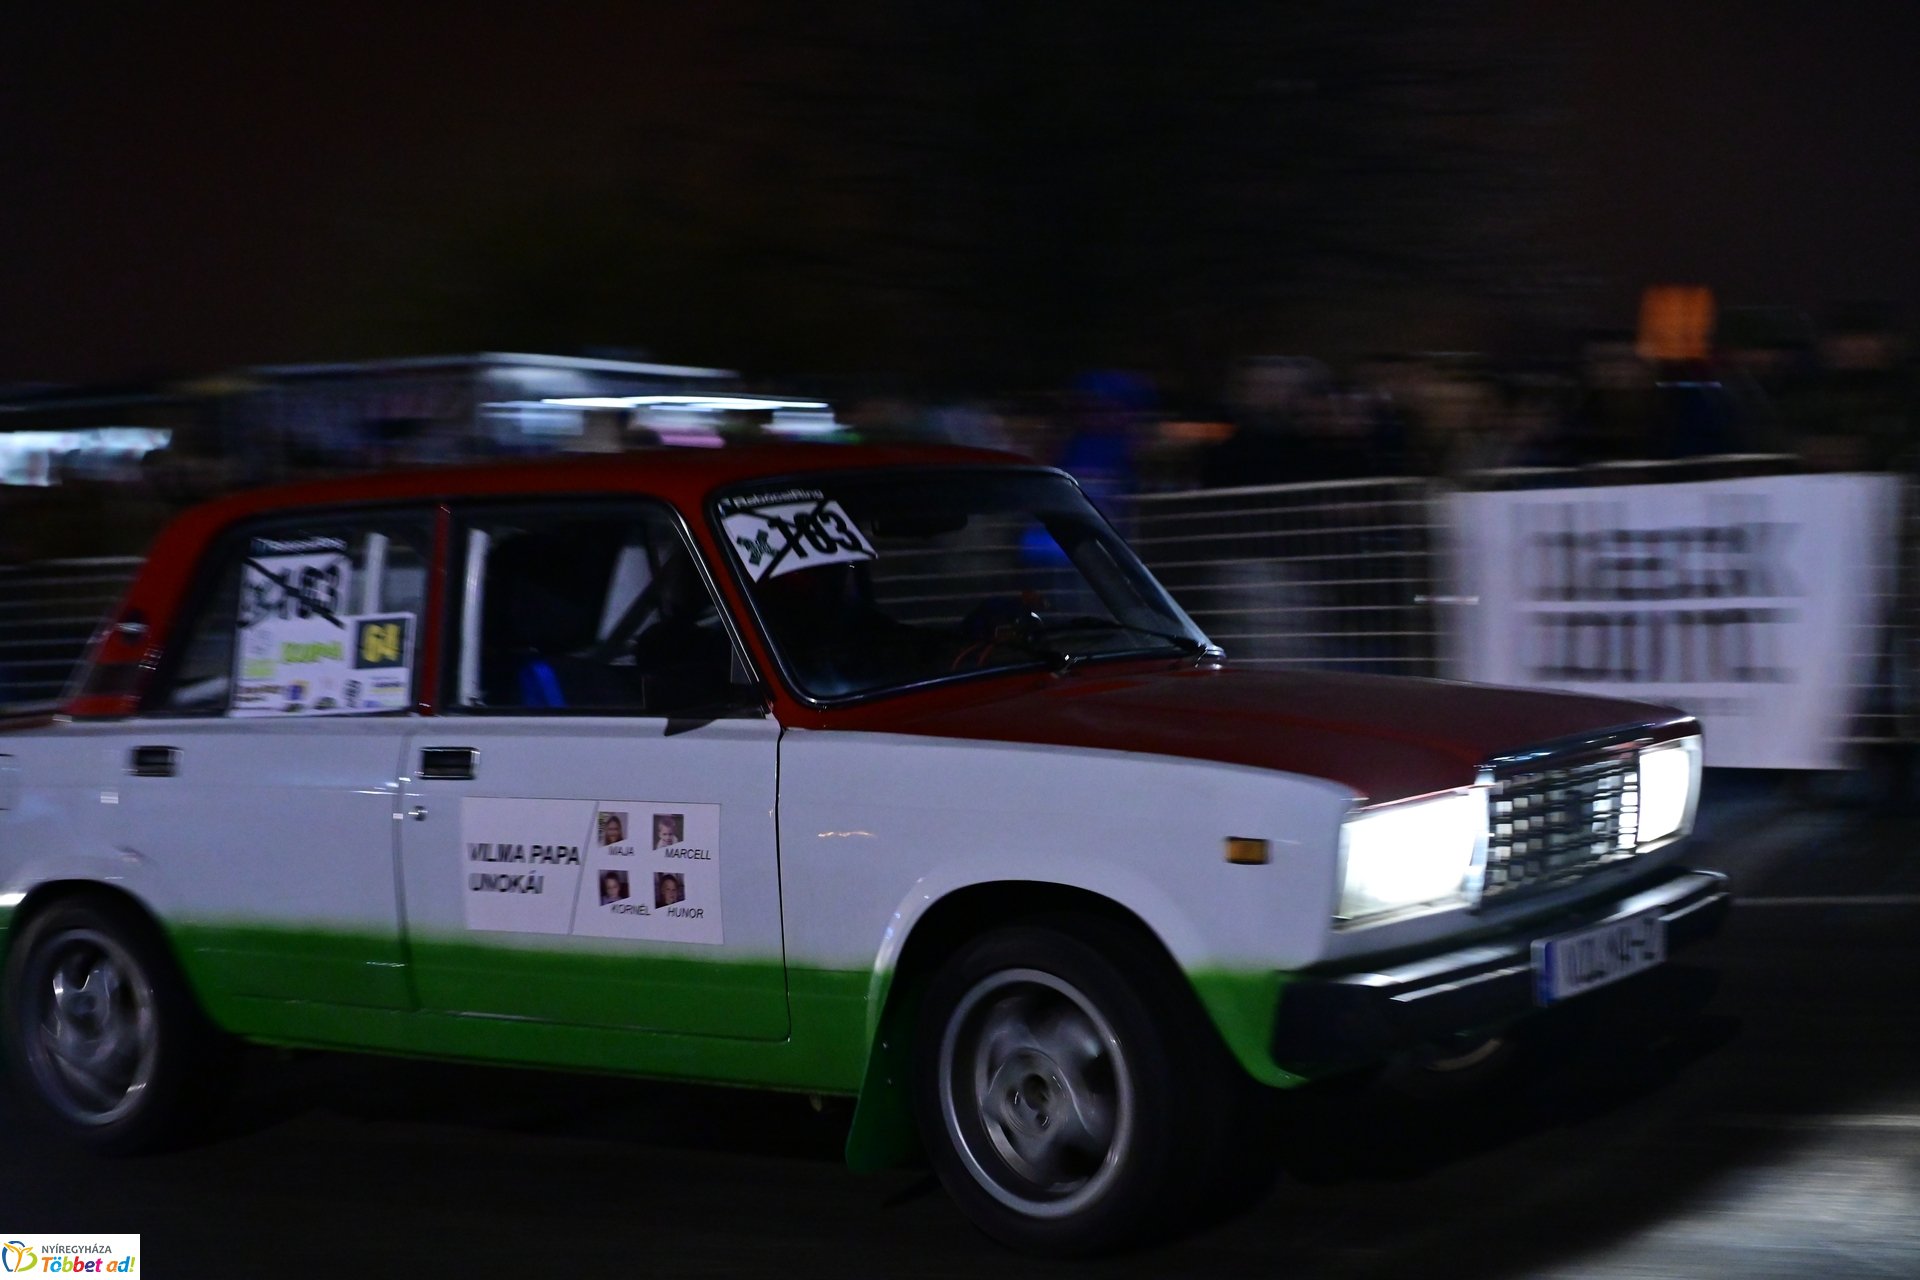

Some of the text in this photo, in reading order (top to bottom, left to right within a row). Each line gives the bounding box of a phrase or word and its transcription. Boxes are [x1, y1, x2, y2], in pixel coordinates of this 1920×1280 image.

[362, 623, 401, 663] 64
[467, 842, 581, 866] VILMA PAPA
[608, 845, 635, 857] MAJA
[665, 847, 711, 860] MARCELL
[468, 870, 544, 894] UNOKÁI
[610, 902, 651, 915] KORNÉL
[667, 906, 704, 919] HUNOR
